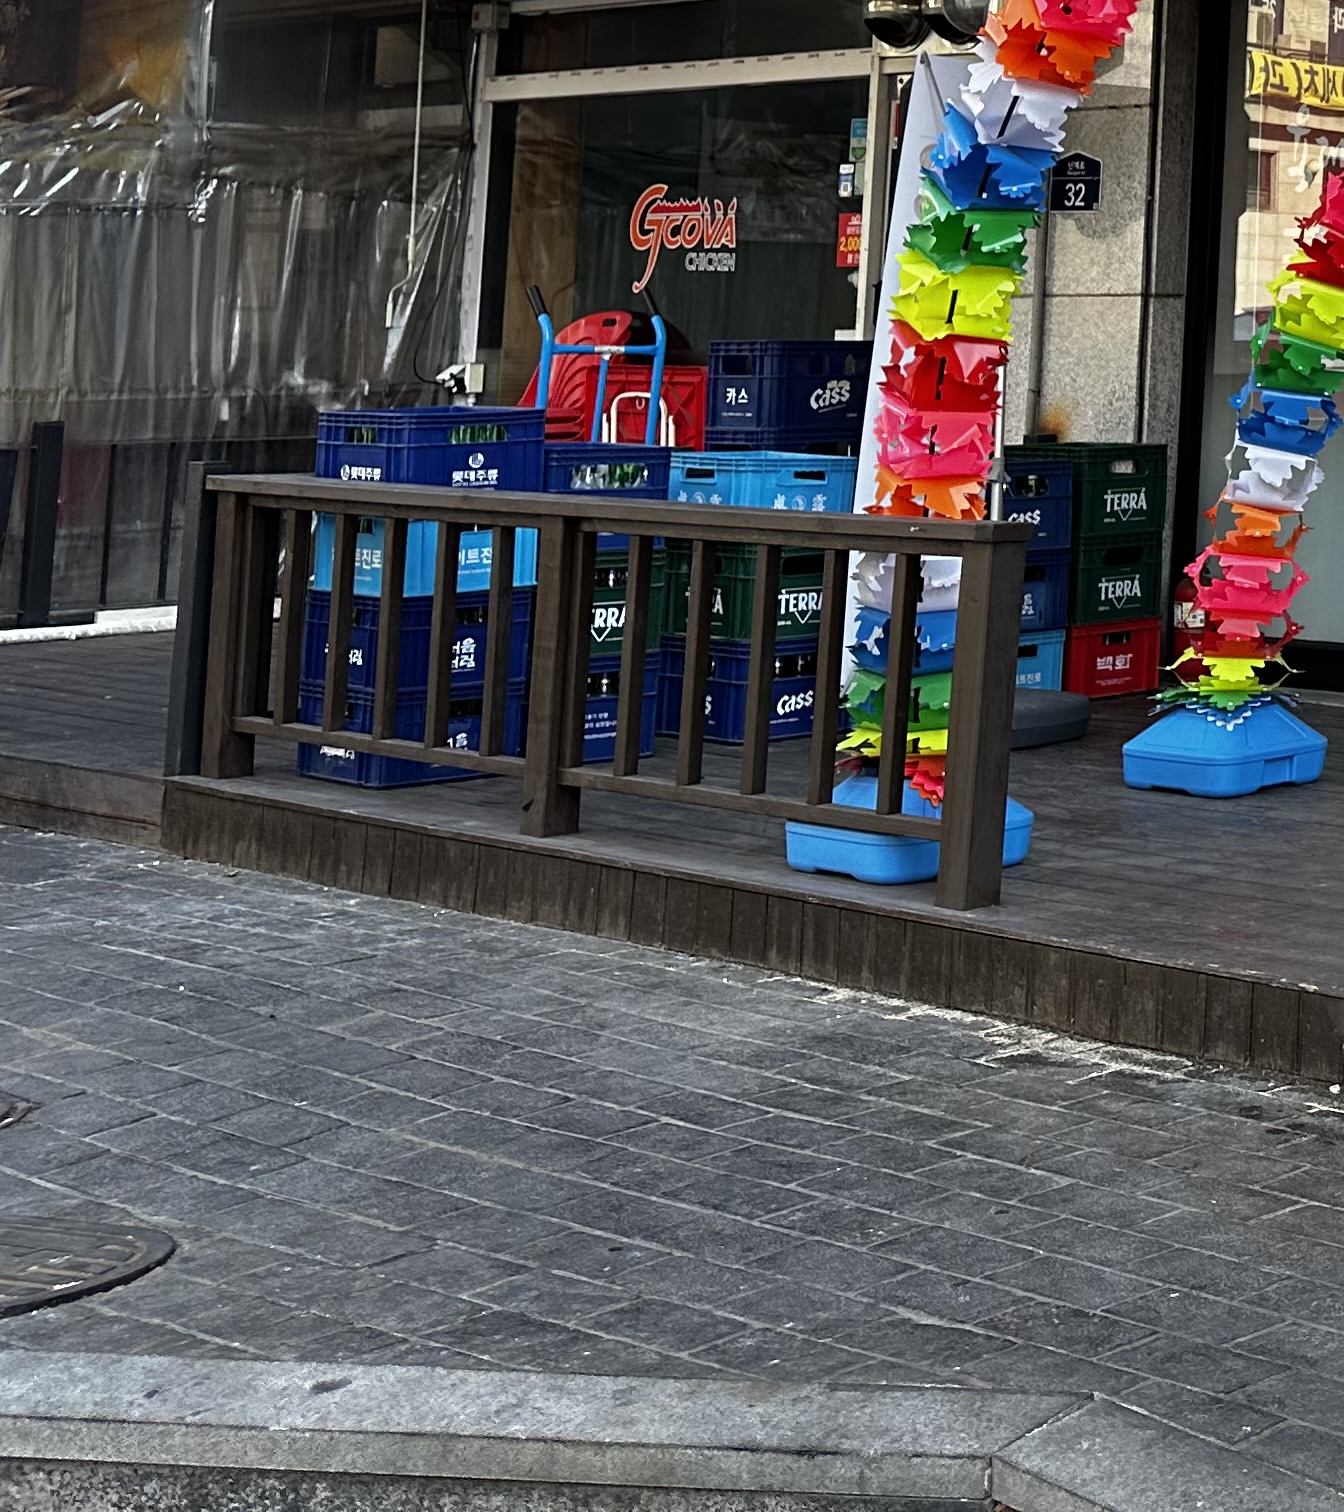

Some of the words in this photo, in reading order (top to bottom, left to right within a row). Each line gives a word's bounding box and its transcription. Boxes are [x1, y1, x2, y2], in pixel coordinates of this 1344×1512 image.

[1064, 182, 1086, 207] 32
[684, 251, 737, 272] CHICKEN
[726, 387, 749, 405] 카스
[452, 469, 499, 482] 롯데주류
[1103, 487, 1147, 513] TERRA
[1098, 574, 1142, 601] TERRA
[776, 690, 814, 716] Cass
